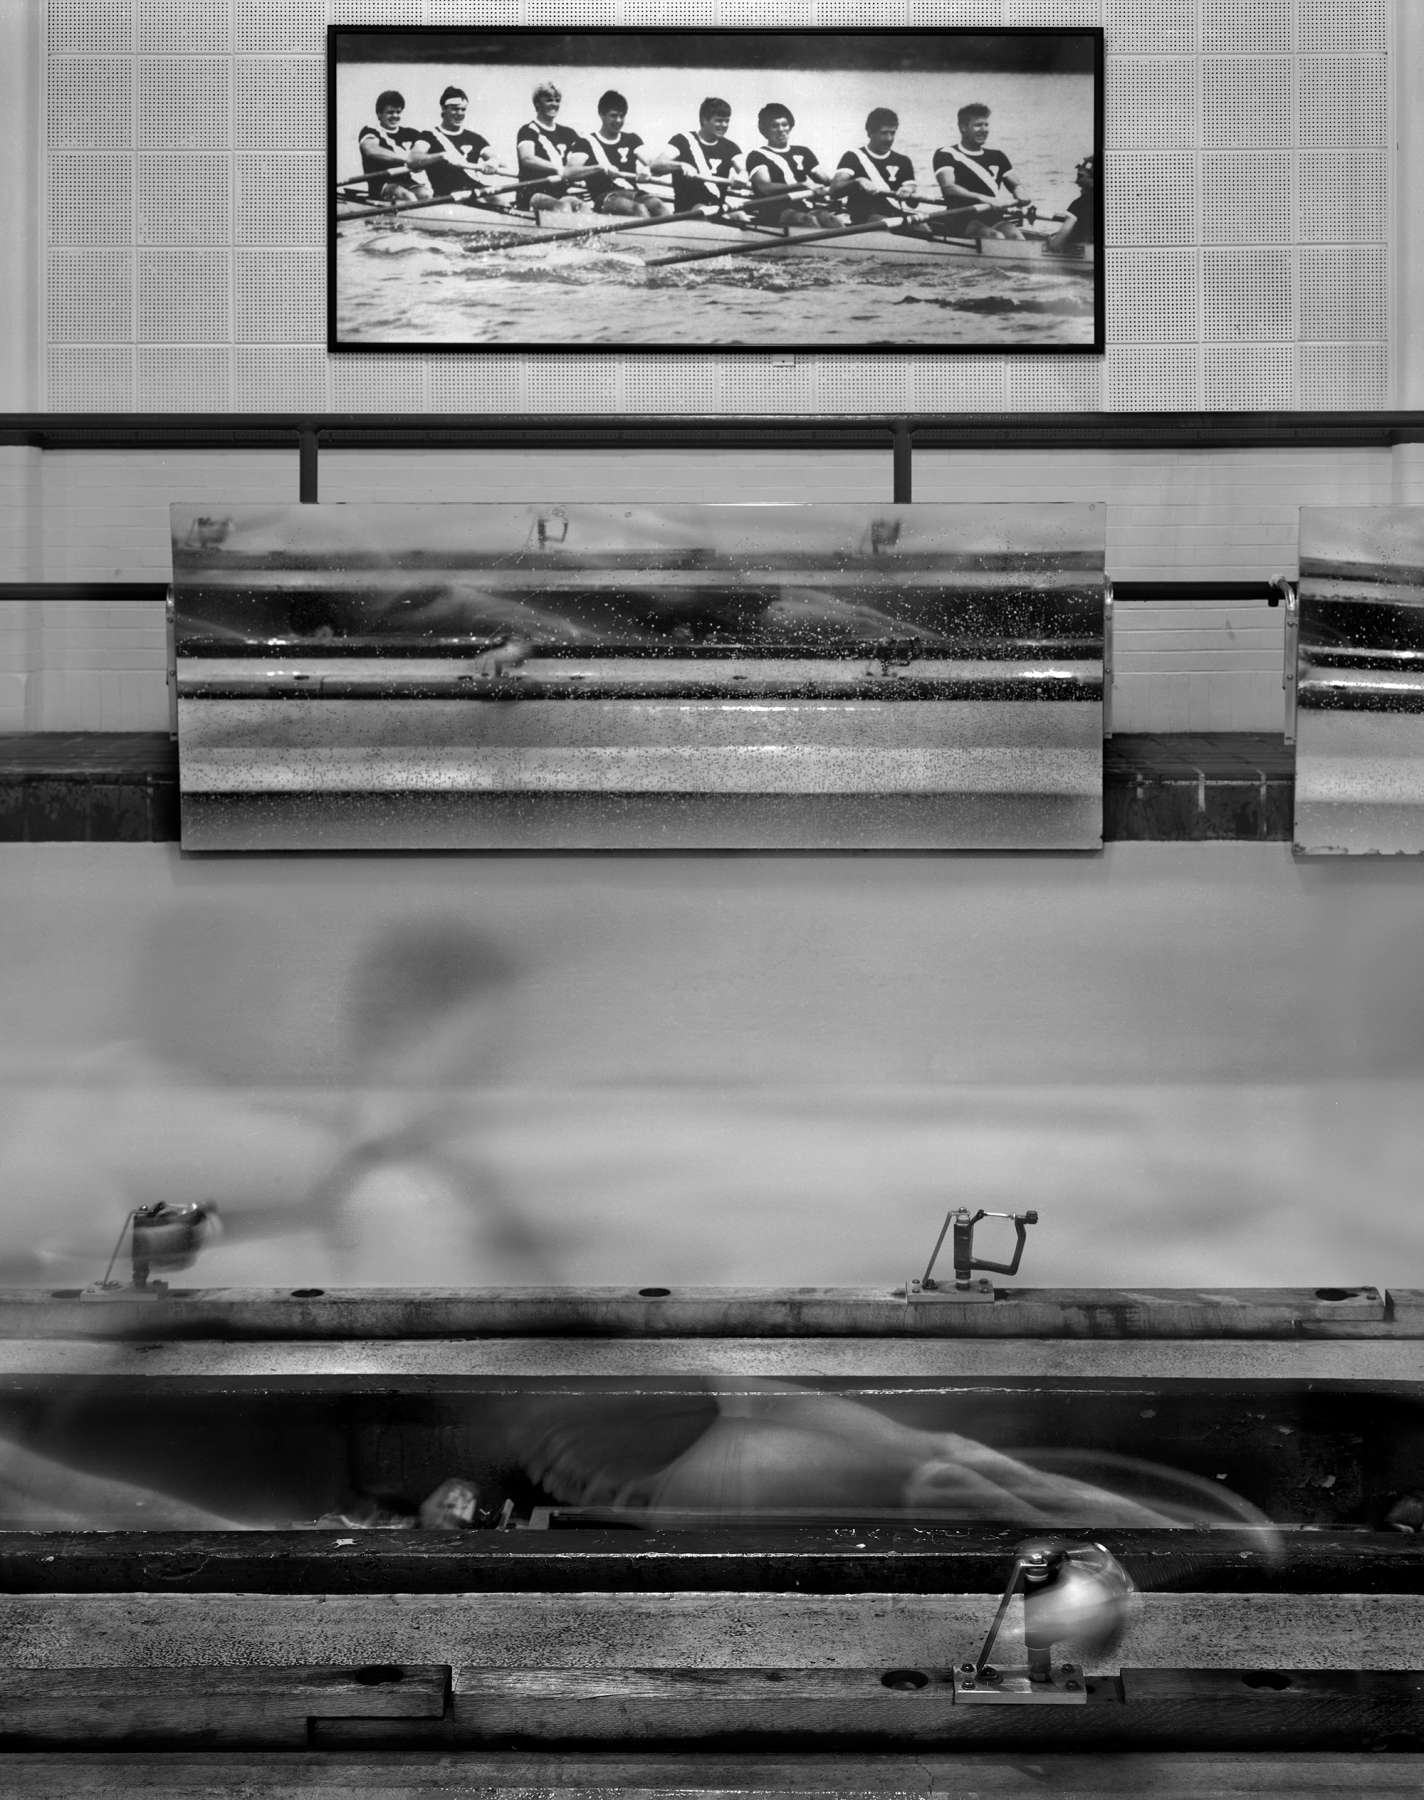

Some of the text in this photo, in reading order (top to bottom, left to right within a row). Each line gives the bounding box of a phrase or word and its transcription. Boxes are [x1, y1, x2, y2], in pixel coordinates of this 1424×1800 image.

[617, 146, 630, 163] Y
[708, 158, 723, 174] Y
[792, 155, 804, 171] Y
[885, 165, 900, 182] Y
